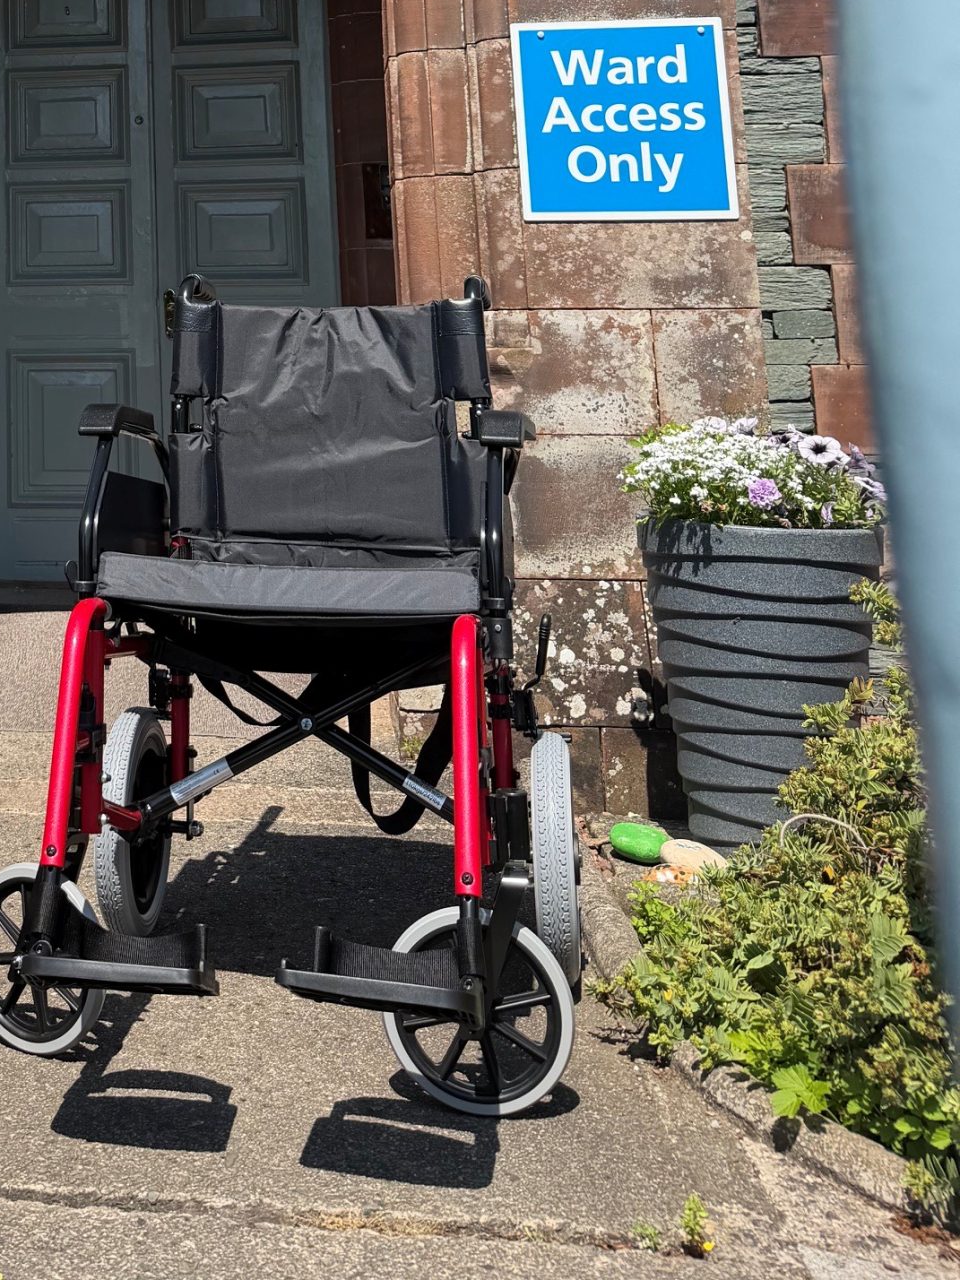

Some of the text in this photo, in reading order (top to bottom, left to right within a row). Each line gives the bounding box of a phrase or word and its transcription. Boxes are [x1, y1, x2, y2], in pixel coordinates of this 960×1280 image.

[550, 43, 688, 86] Ward
[541, 96, 707, 134] Access
[567, 141, 684, 194] Only
